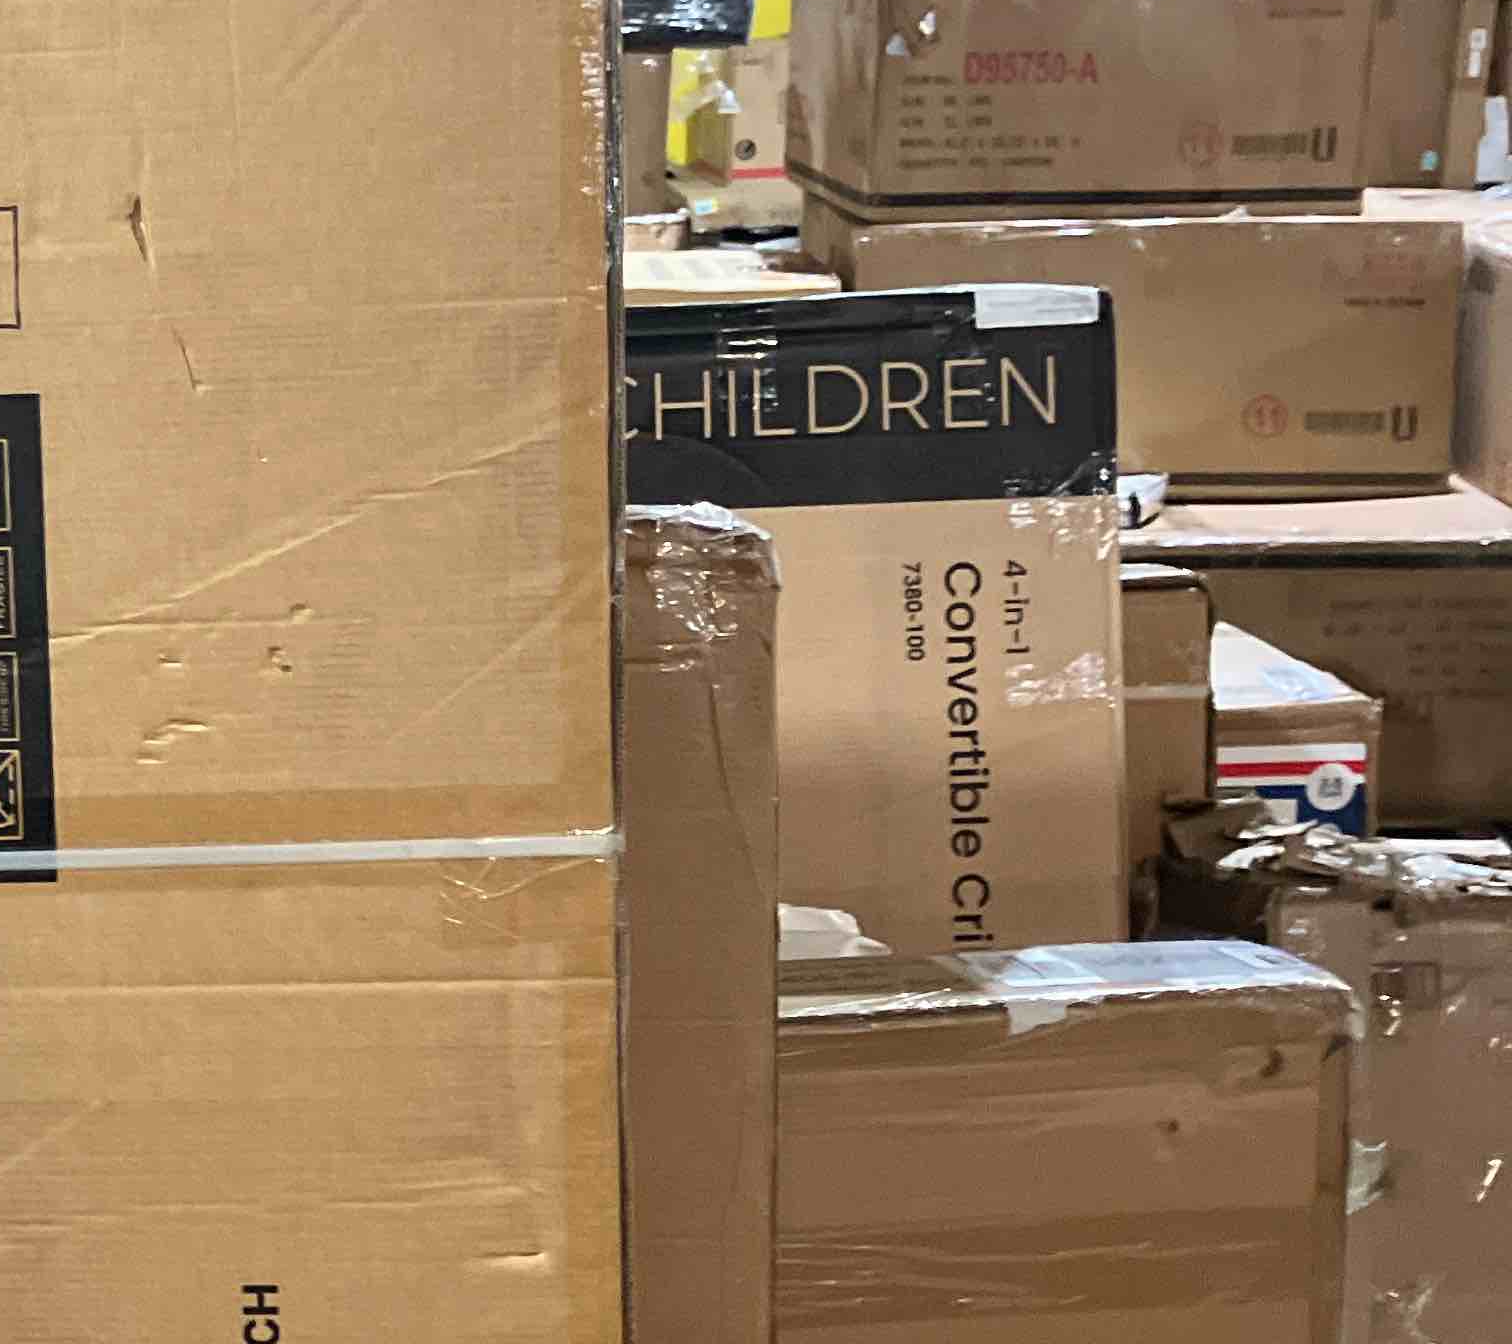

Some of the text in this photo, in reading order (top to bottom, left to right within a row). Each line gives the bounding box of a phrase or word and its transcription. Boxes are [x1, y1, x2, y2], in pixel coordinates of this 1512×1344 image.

[902, 561, 927, 662] 7380-100
[1002, 558, 1031, 655] 4-in-1
[943, 561, 993, 860] Convertible
